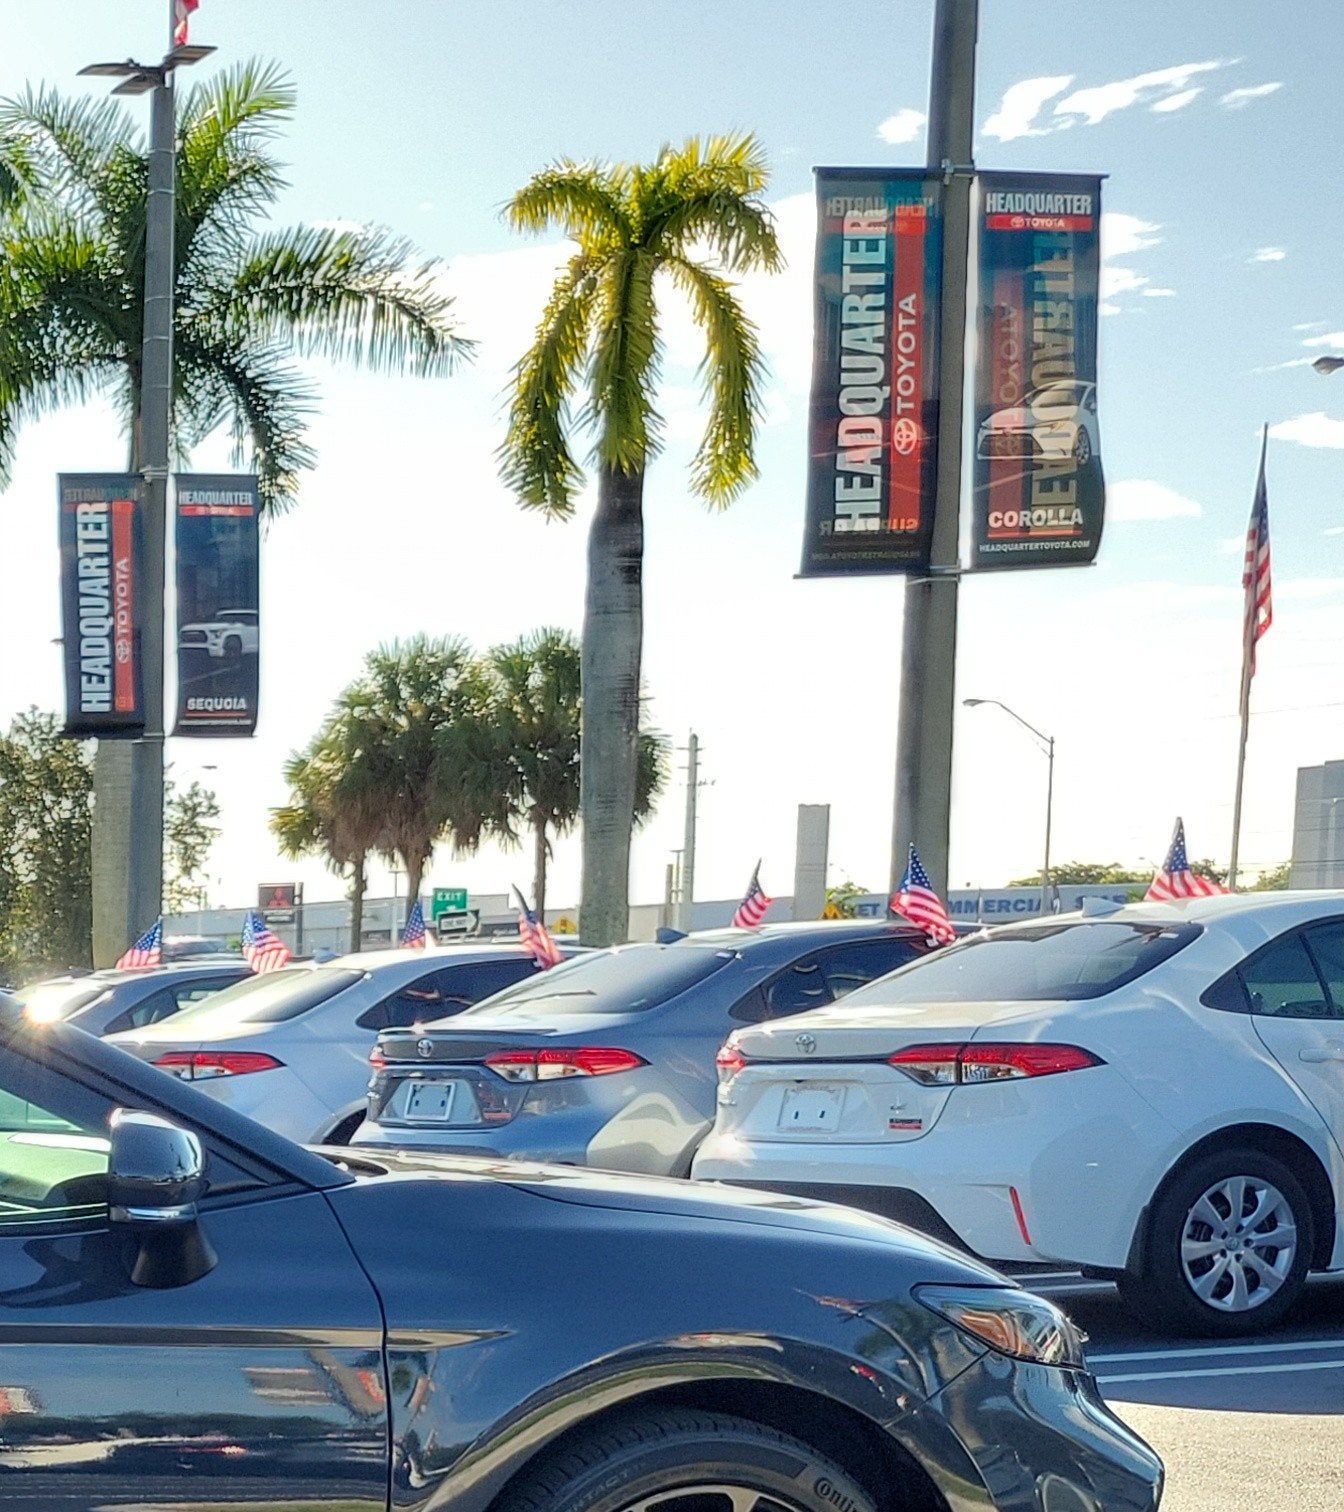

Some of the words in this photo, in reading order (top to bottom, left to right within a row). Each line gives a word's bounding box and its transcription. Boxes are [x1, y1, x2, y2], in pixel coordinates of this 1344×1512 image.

[985, 192, 1092, 215] HEADQUARTER
[1025, 218, 1065, 229] TOYOTA
[895, 293, 918, 415] TOYOTA
[833, 207, 890, 533] HEADQUARTER
[988, 508, 1084, 528] COROLLA
[979, 540, 1091, 552] HEADQUARTERTOYOTA.COM
[76, 501, 114, 713] HEADQUARTER
[115, 558, 130, 638] TOYOTA
[187, 697, 247, 711] SEQUOIA
[436, 892, 462, 902] EXIT
